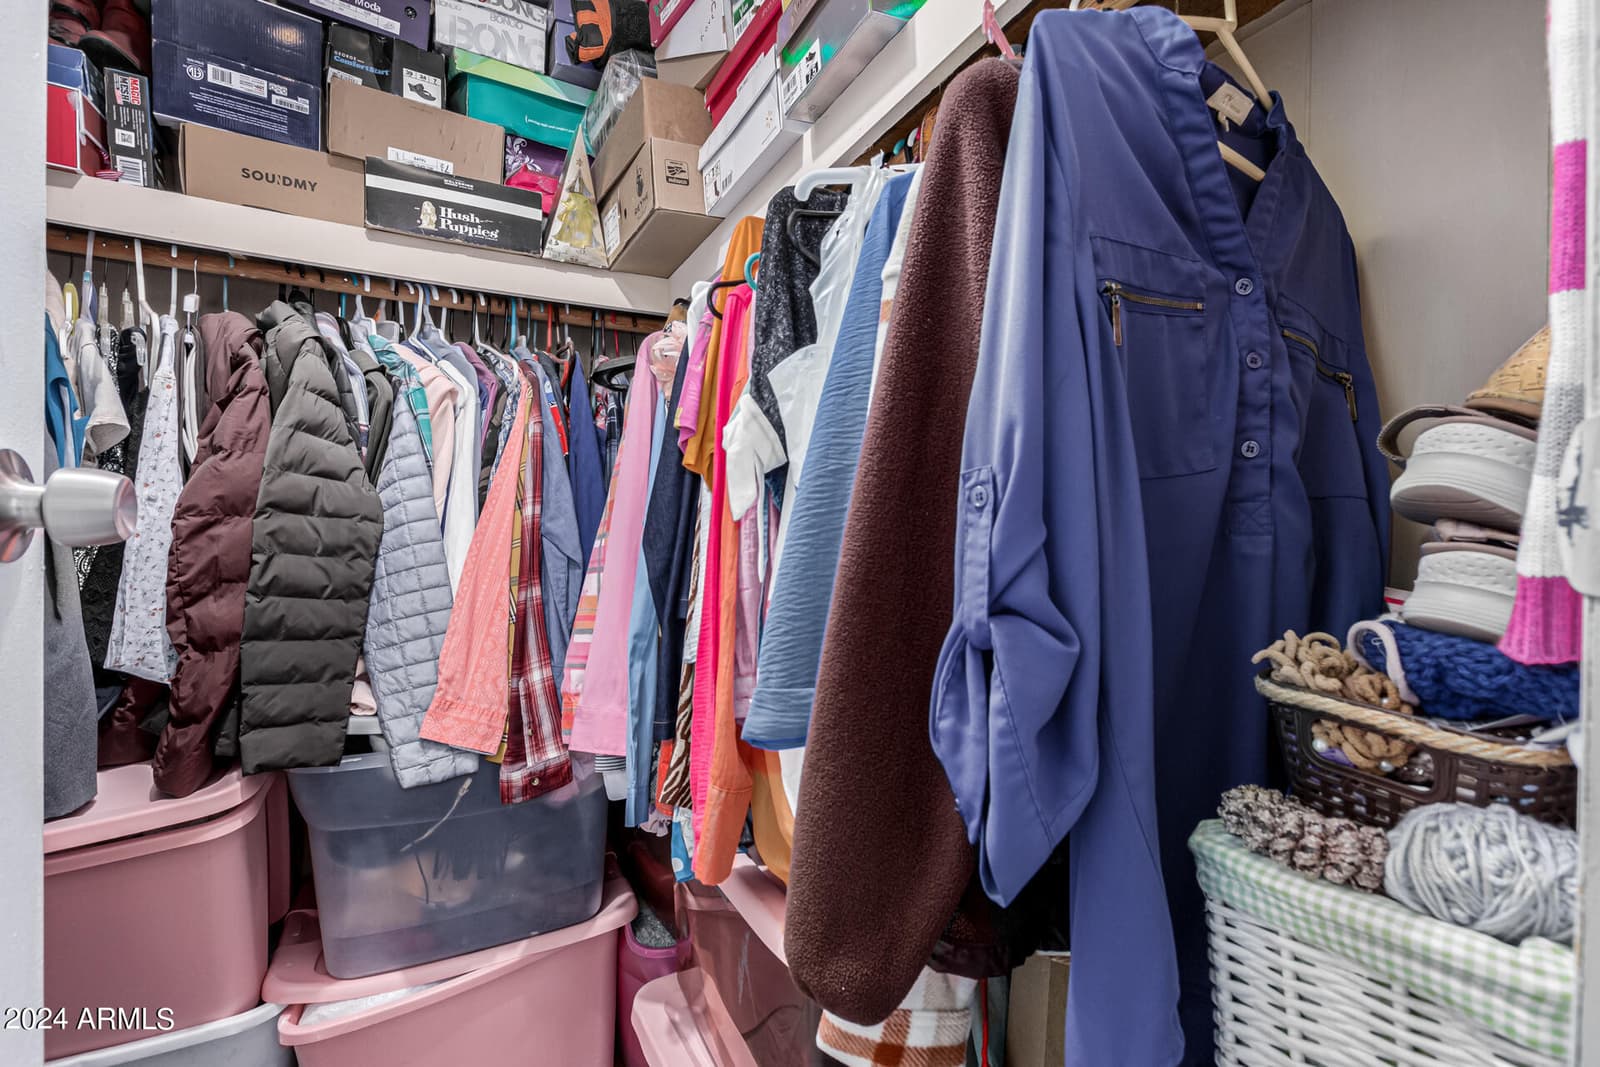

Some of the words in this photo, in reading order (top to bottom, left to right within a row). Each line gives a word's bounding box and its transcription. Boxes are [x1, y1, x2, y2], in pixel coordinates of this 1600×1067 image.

[119, 76, 131, 103] MESH
[130, 77, 141, 105] MAGIC
[439, 206, 481, 223] Hush
[439, 217, 499, 238] Puppies
